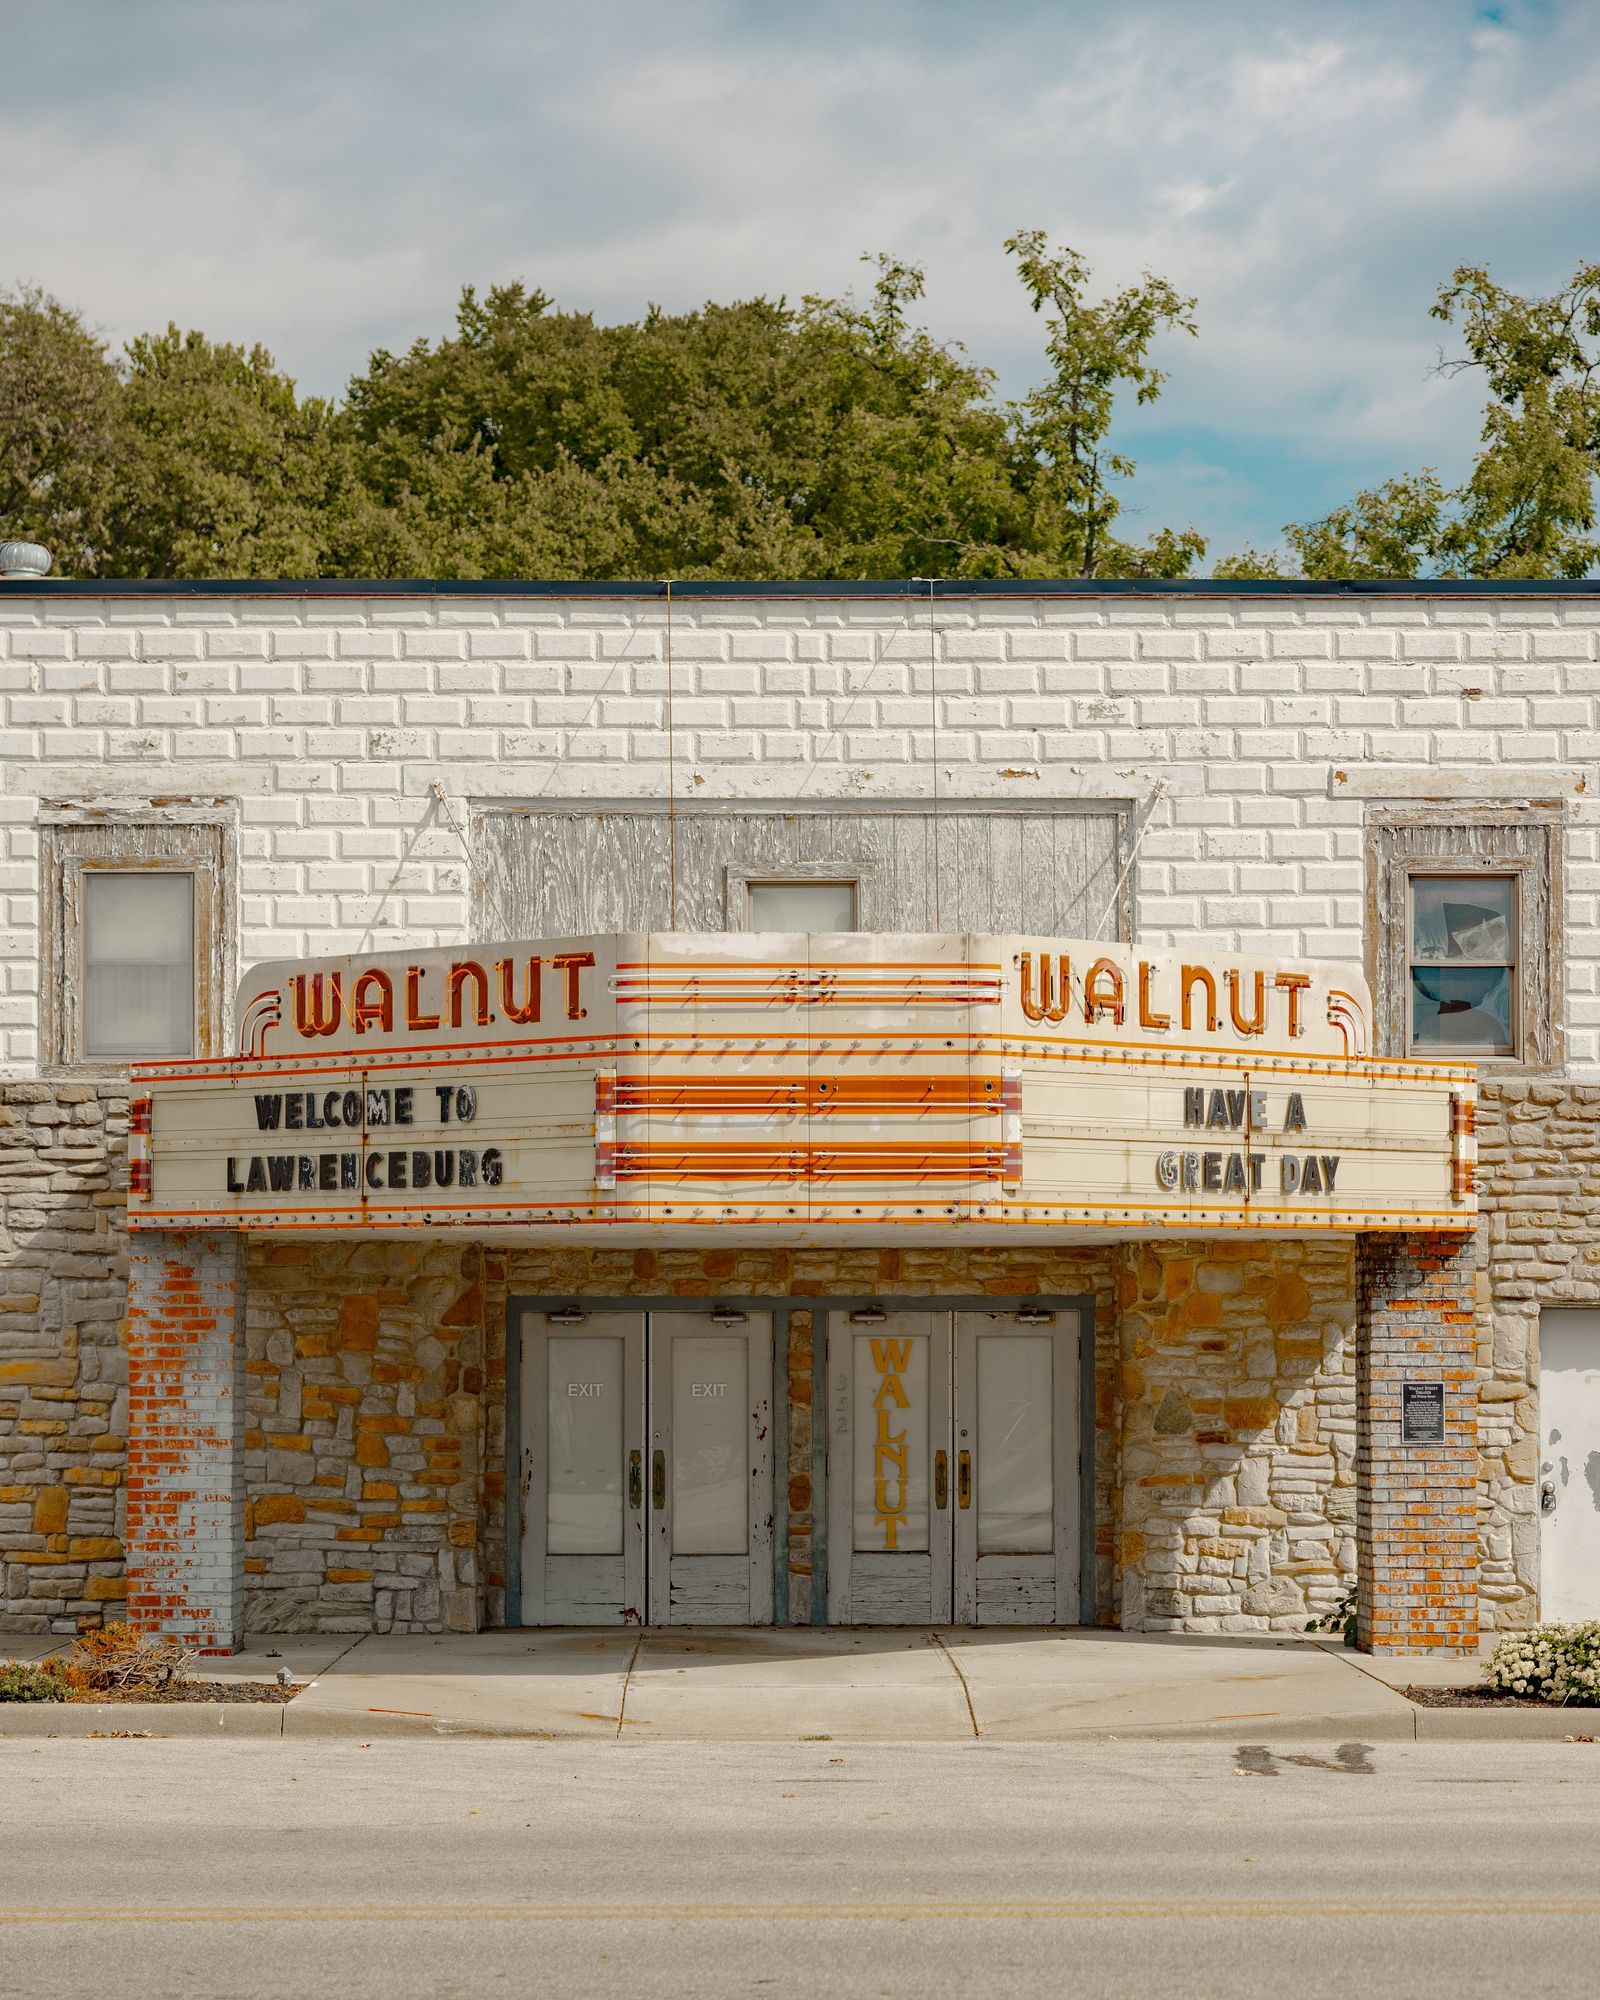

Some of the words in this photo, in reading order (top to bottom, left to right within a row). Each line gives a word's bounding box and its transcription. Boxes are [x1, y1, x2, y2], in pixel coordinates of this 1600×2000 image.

[289, 952, 595, 1038] WALNUT
[1019, 951, 1311, 1037] WALNUT
[254, 1085, 413, 1131] WELCOME
[435, 1083, 477, 1124] TO
[1184, 1086, 1268, 1129] HAVE
[1286, 1092, 1308, 1130] A
[226, 1148, 503, 1193] LAWRENCEBURG
[1158, 1150, 1266, 1192] GREAT
[1282, 1154, 1340, 1193] DAY
[568, 1383, 604, 1397] EXIT
[691, 1383, 728, 1397] EXIT
[869, 1338, 914, 1550] WALNUT
